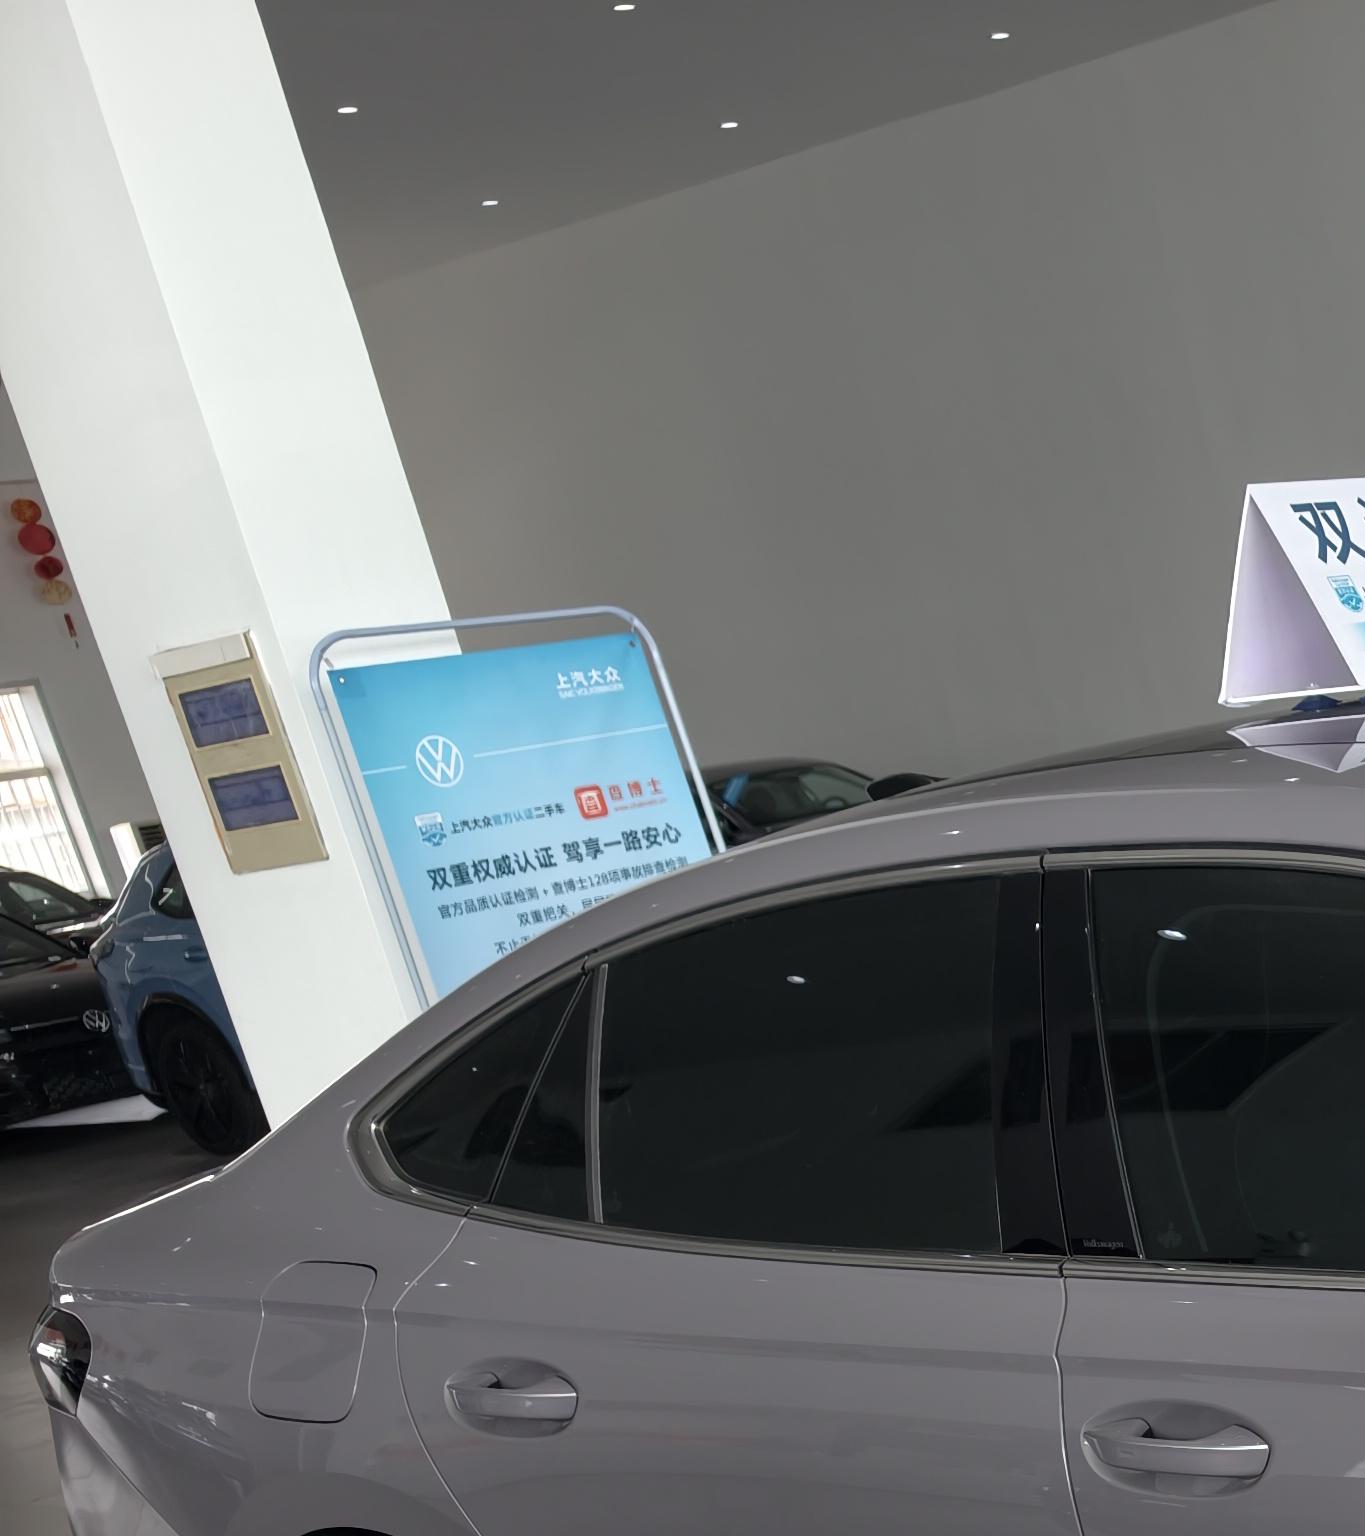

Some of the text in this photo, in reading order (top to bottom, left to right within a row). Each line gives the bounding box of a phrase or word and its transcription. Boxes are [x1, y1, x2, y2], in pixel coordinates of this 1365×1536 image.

[556, 666, 622, 689] 上汽大众
[450, 803, 566, 835] 上汽大众官方认证二手车
[427, 822, 683, 891] 双重权威认证 驾享一路安心
[438, 886, 540, 919] 官方品质认证检测
